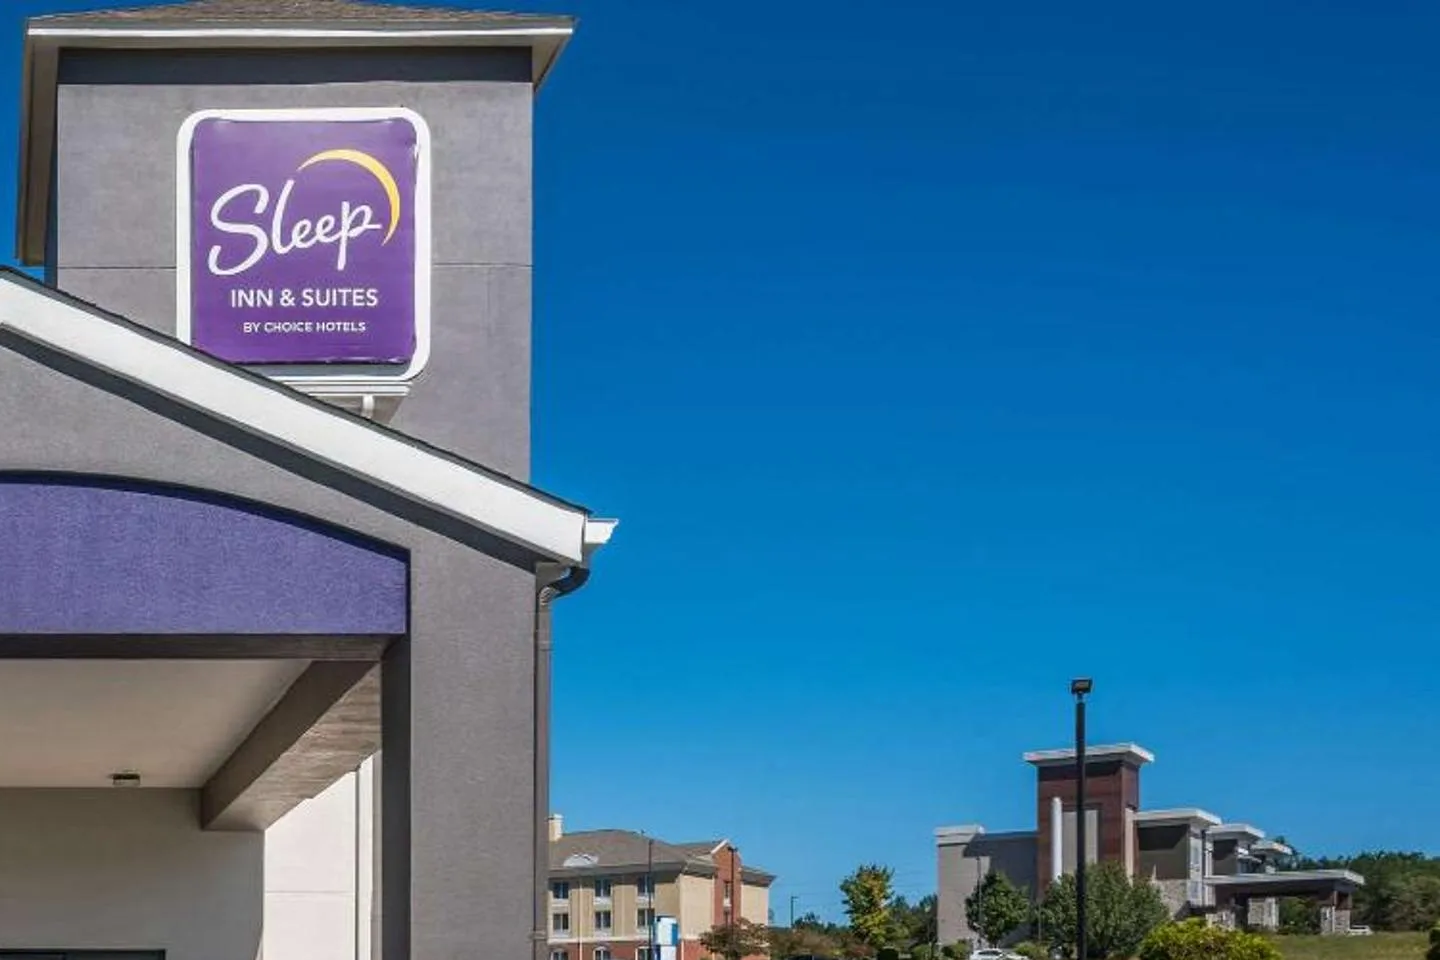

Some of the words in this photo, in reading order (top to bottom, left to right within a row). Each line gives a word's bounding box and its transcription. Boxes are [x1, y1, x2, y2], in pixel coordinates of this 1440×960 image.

[208, 179, 382, 275] Sleep
[231, 288, 273, 308] INN
[279, 288, 296, 307] &
[302, 288, 379, 307] SUITES
[243, 322, 261, 333] BY
[264, 322, 312, 333] CHOICE
[316, 321, 366, 332] HOTELS
